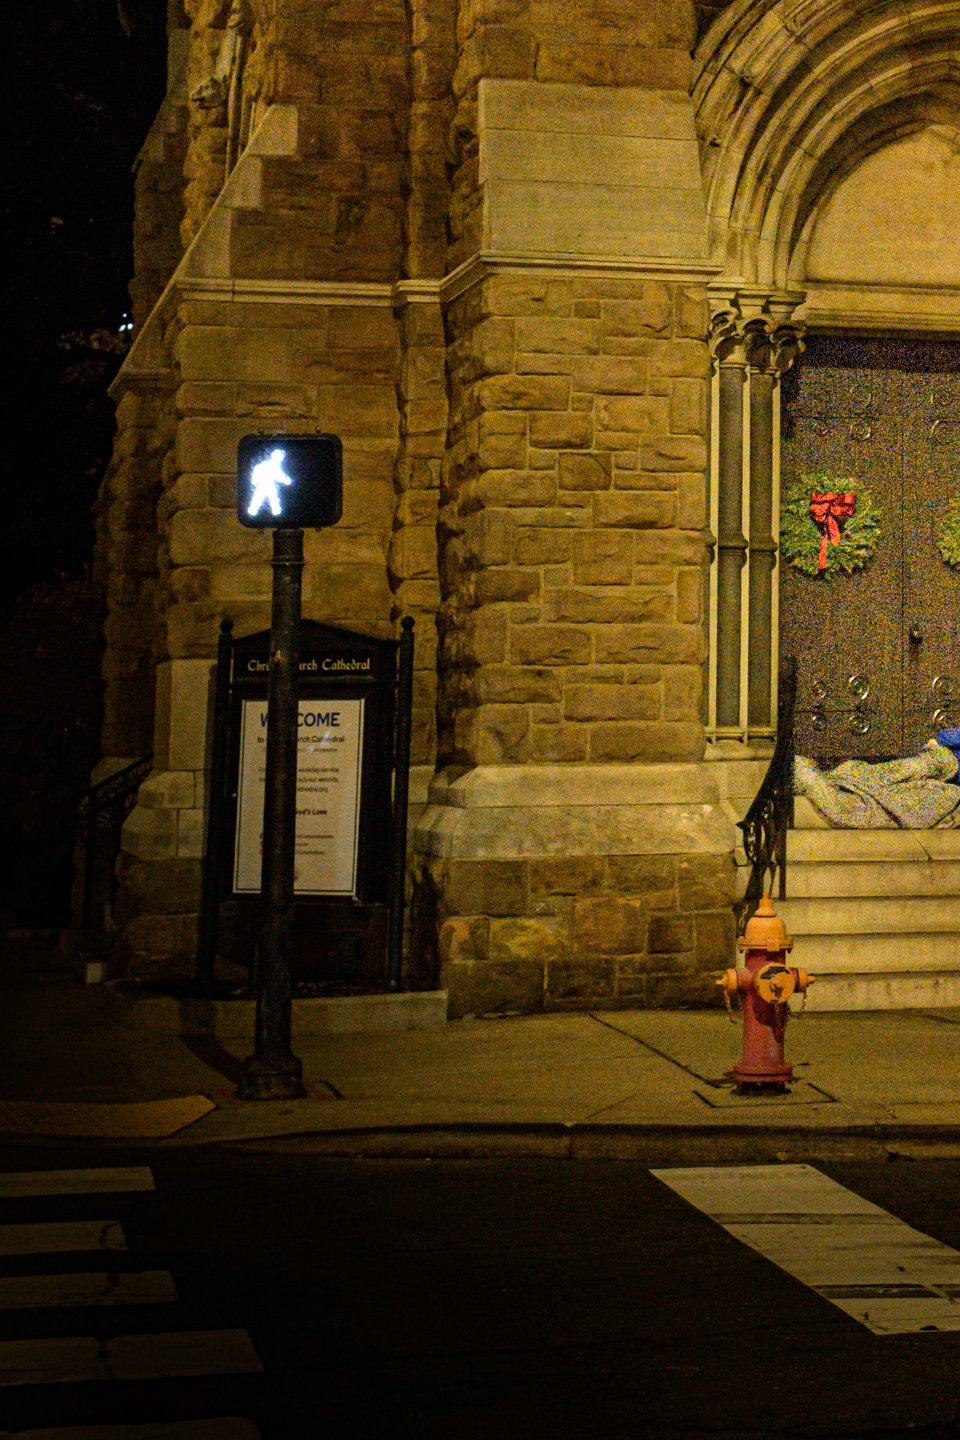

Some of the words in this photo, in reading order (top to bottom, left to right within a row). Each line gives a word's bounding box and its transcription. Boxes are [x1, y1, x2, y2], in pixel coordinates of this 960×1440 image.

[247, 659, 270, 672] Chri
[297, 659, 317, 672] urch
[320, 657, 370, 672] Cathedral
[260, 712, 340, 728] WCOME
[256, 736, 264, 744] to
[312, 808, 328, 816] Love
